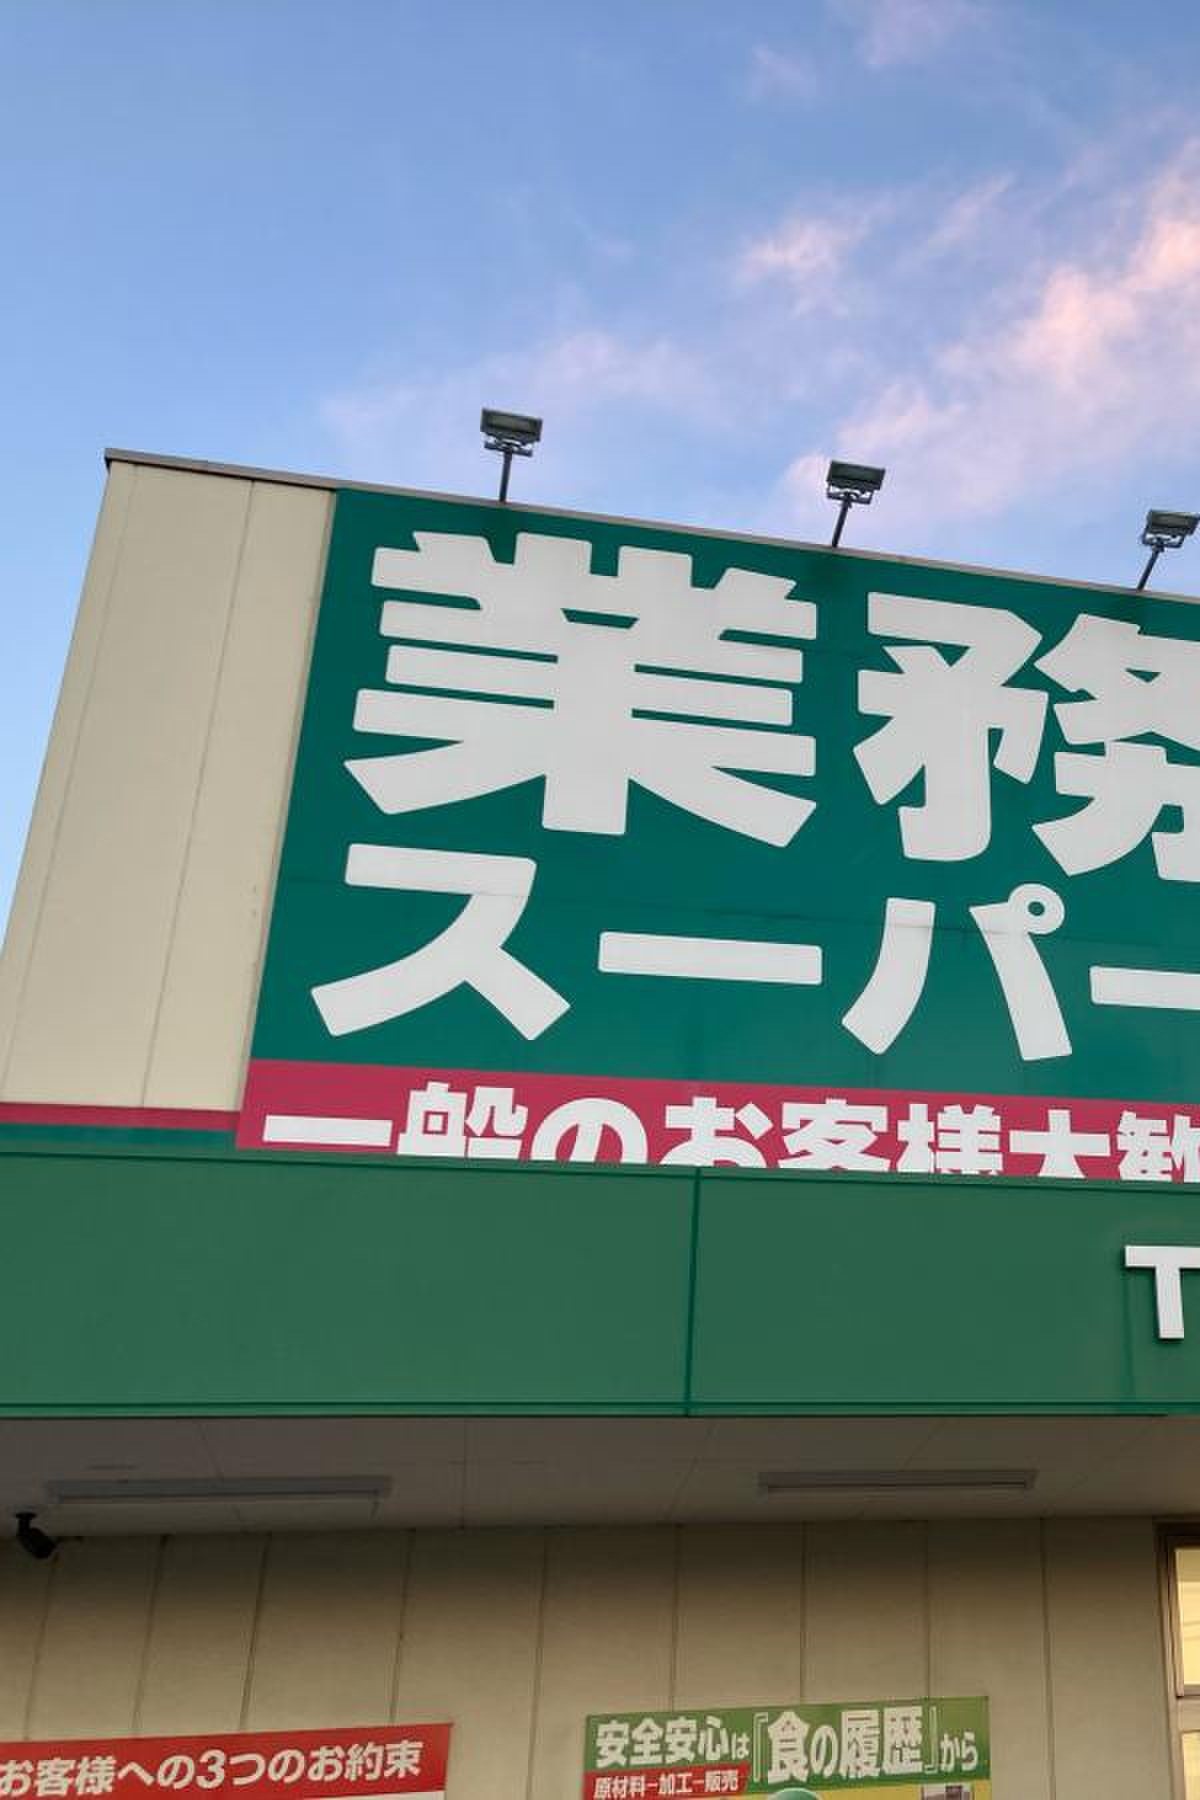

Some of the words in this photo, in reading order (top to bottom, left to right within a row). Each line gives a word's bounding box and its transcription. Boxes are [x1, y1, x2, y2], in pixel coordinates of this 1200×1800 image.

[0, 1740, 424, 1798] お客様への3つのお約束
